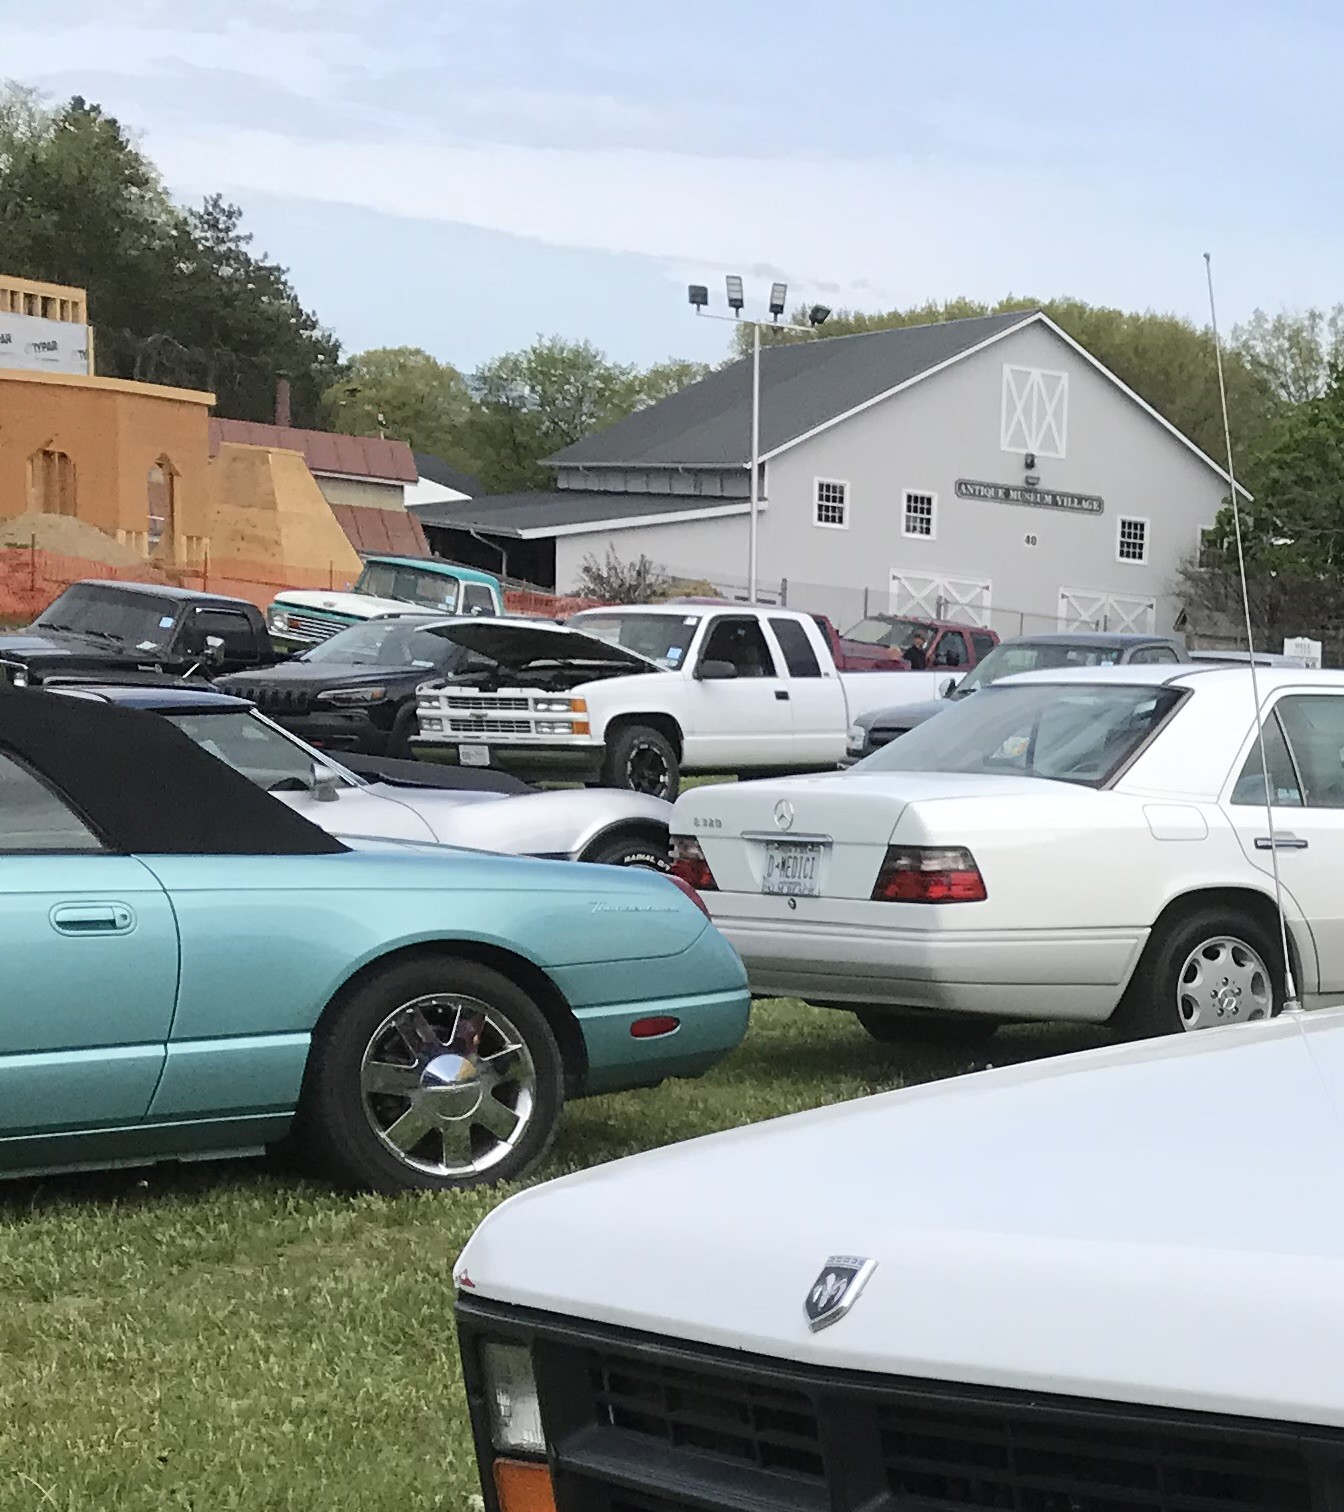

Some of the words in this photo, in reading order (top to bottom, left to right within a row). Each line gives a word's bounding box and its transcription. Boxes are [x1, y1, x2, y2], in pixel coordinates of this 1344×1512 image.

[960, 484, 1006, 498] ANTIQUE
[1009, 489, 1053, 505] MUSEUM
[1056, 495, 1100, 510] VILLAGE
[624, 853, 656, 864] RADIAL
